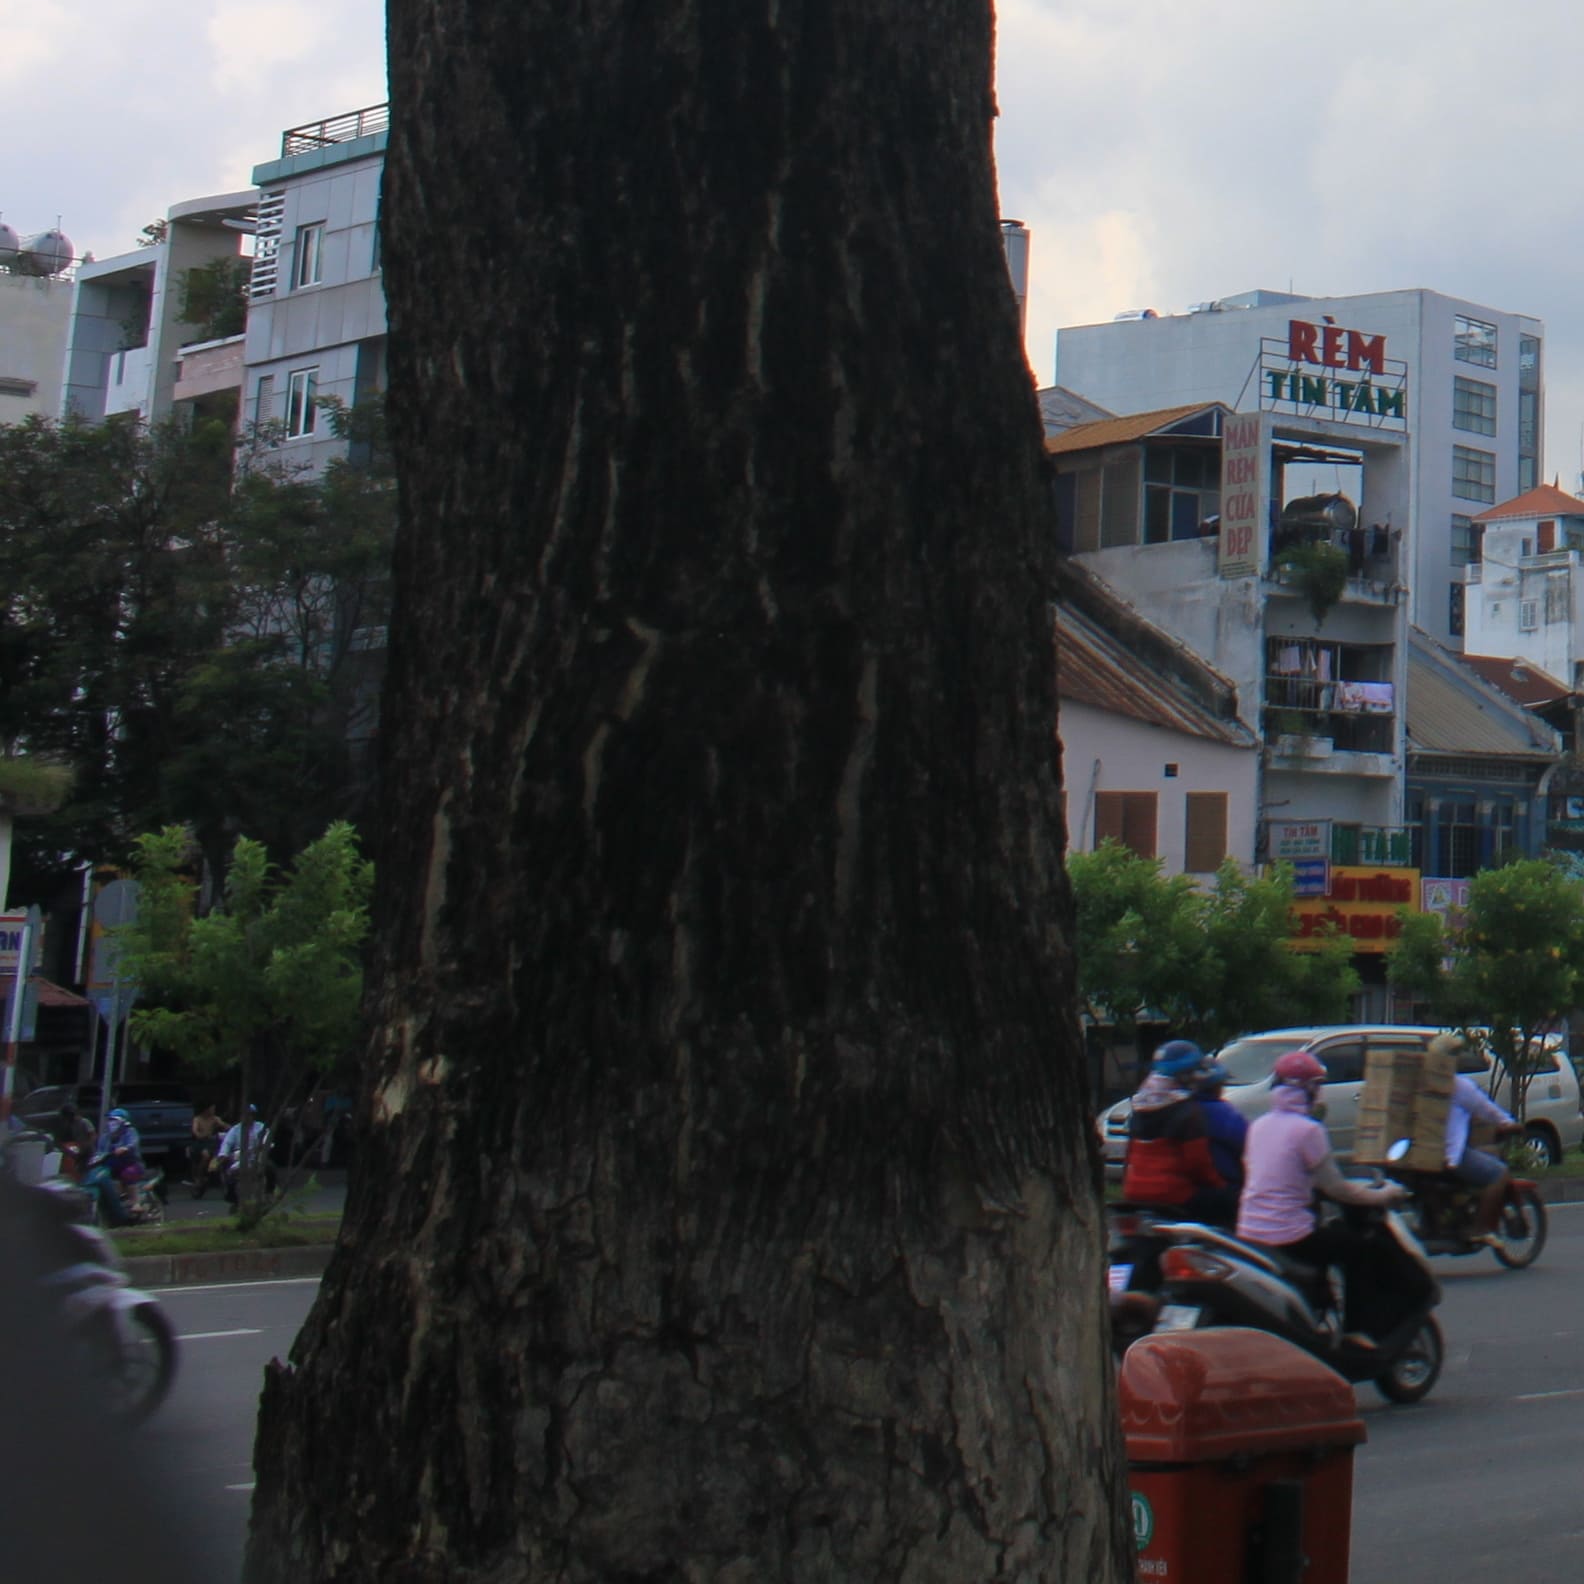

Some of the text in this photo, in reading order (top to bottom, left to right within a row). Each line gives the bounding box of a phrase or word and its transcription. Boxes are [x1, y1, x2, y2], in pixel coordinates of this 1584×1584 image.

[1288, 316, 1387, 376] RÈM
[1266, 368, 1405, 419] TÍN TÂM
